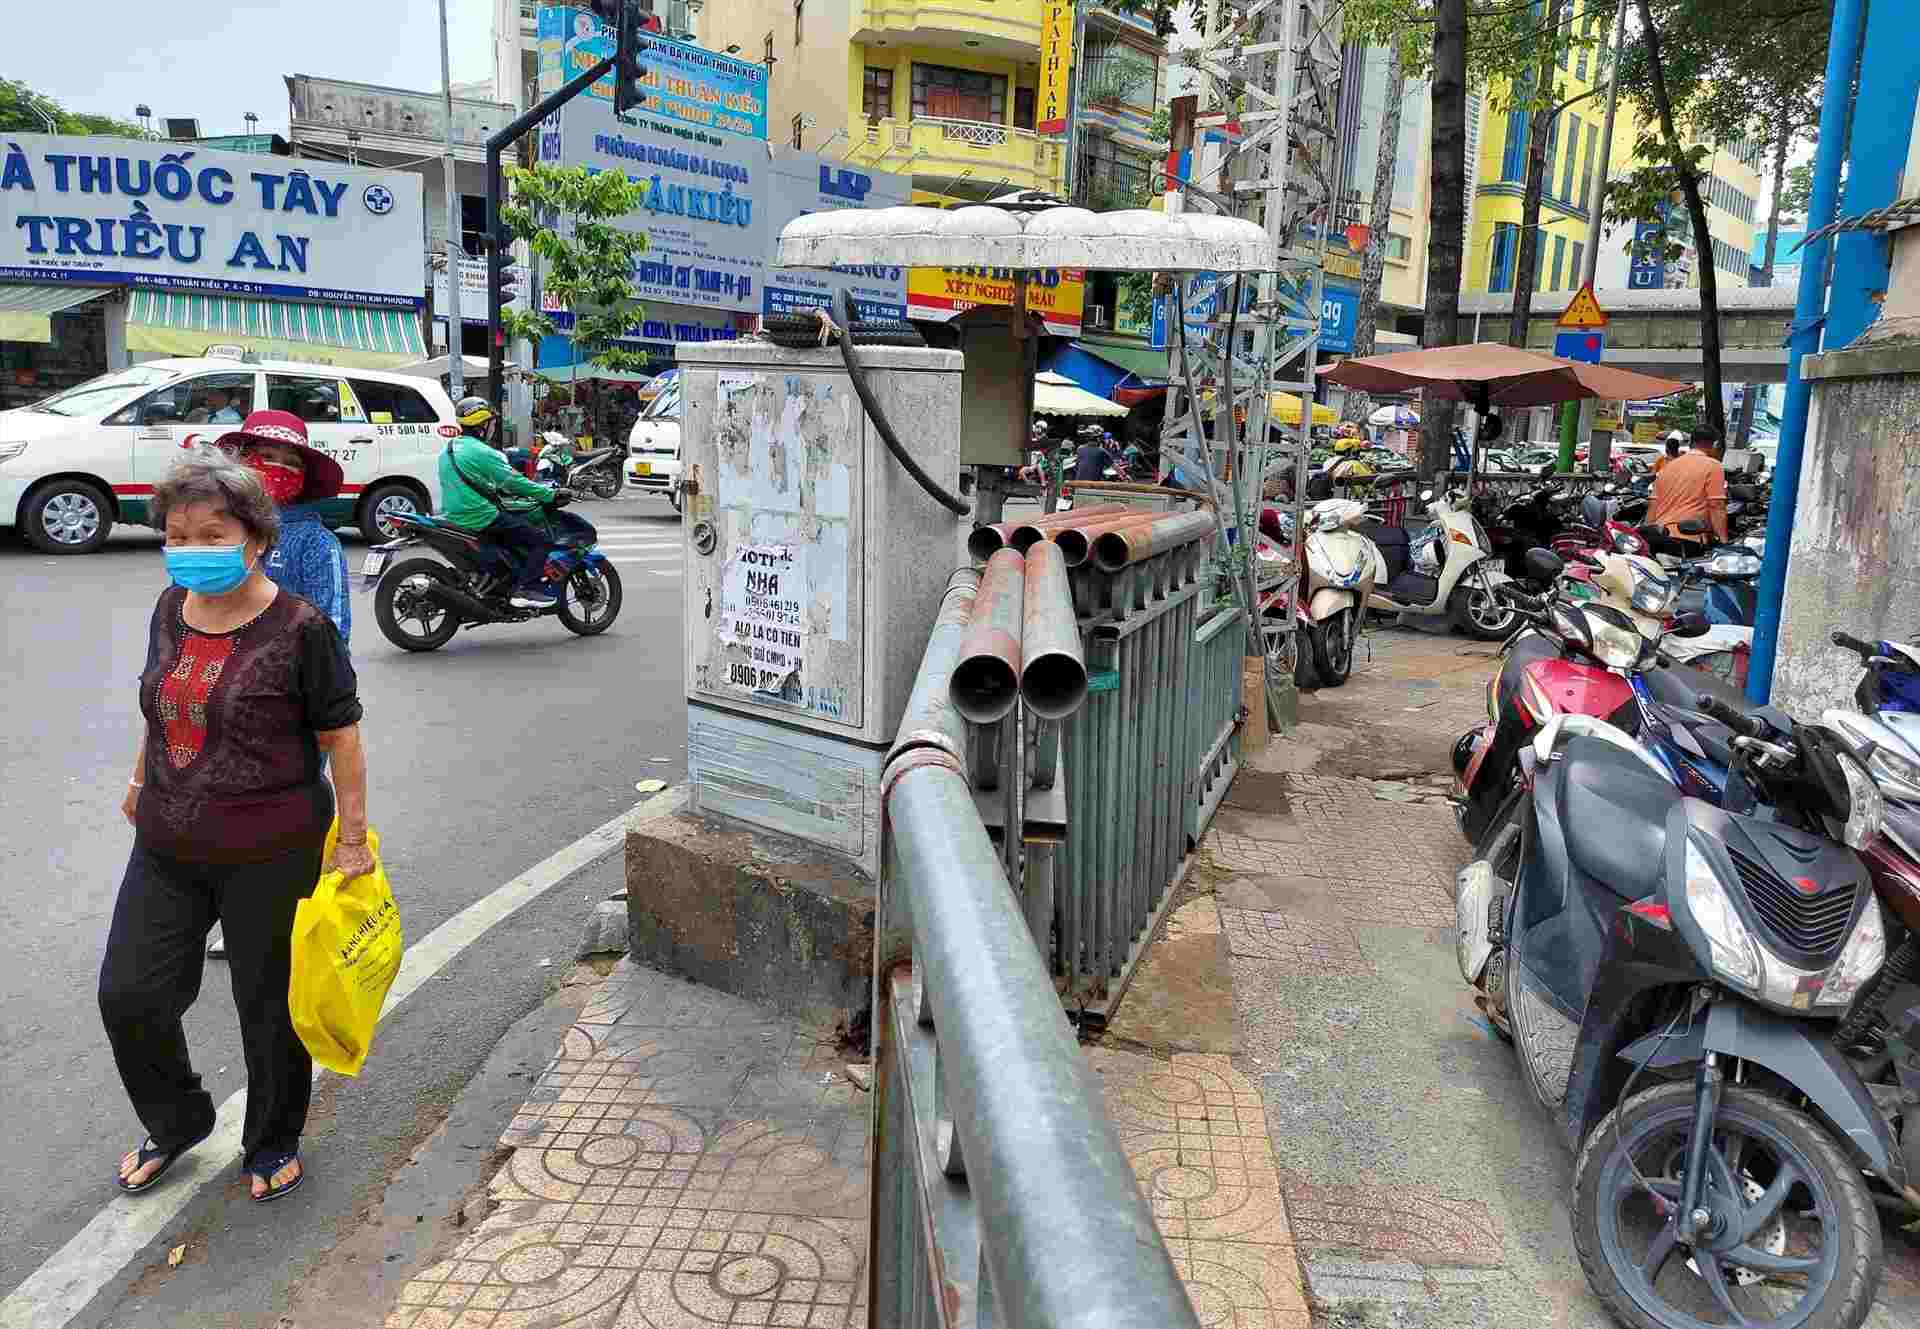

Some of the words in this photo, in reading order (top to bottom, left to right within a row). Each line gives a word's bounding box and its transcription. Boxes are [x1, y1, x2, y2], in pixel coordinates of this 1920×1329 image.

[685, 47, 710, 66] KHOA
[1046, 7, 1063, 121] PATHLAB
[639, 118, 650, 129] TY
[45, 151, 235, 205] THUỐC
[250, 168, 350, 217] TÂY
[647, 146, 689, 171] KHÁM
[711, 159, 750, 185] KHOA
[16, 200, 206, 264] TRIỀU
[226, 230, 310, 273] AN
[730, 663, 757, 688] 0906
